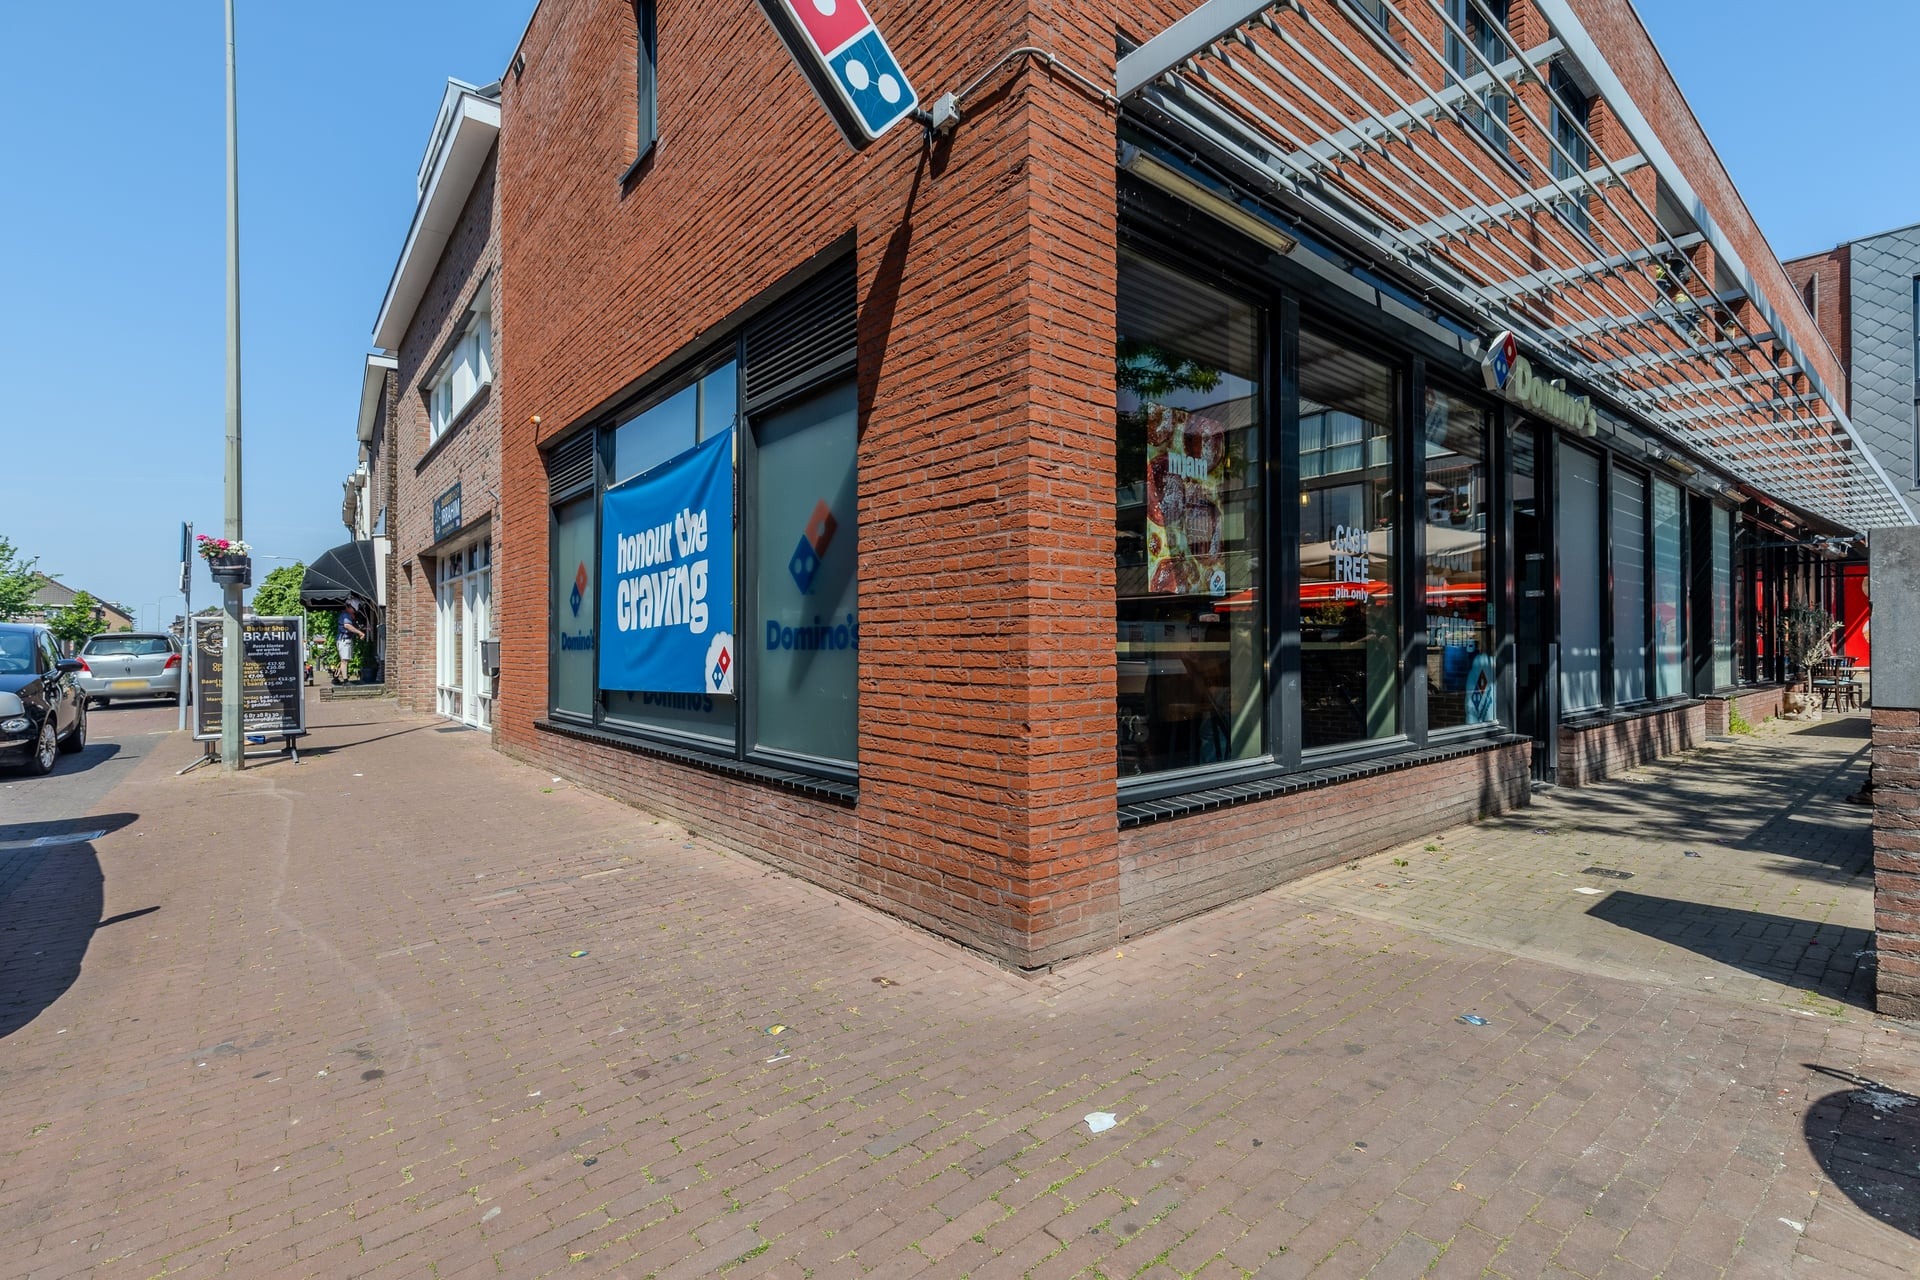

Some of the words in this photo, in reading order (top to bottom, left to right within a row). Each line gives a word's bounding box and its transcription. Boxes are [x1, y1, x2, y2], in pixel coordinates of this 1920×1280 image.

[1512, 354, 1598, 437] Domino's
[1167, 451, 1209, 481] mjam
[616, 520, 674, 575] honour
[674, 507, 708, 558] the
[1335, 524, 1369, 555] CASH
[1335, 555, 1369, 584] FREE
[616, 559, 709, 634] craving
[1335, 585, 1349, 600] pin
[1351, 588, 1369, 604] only
[242, 631, 297, 641] BRAHIM
[271, 625, 290, 633] Shop
[766, 613, 858, 650] Domino's
[643, 691, 713, 713] Dominos
